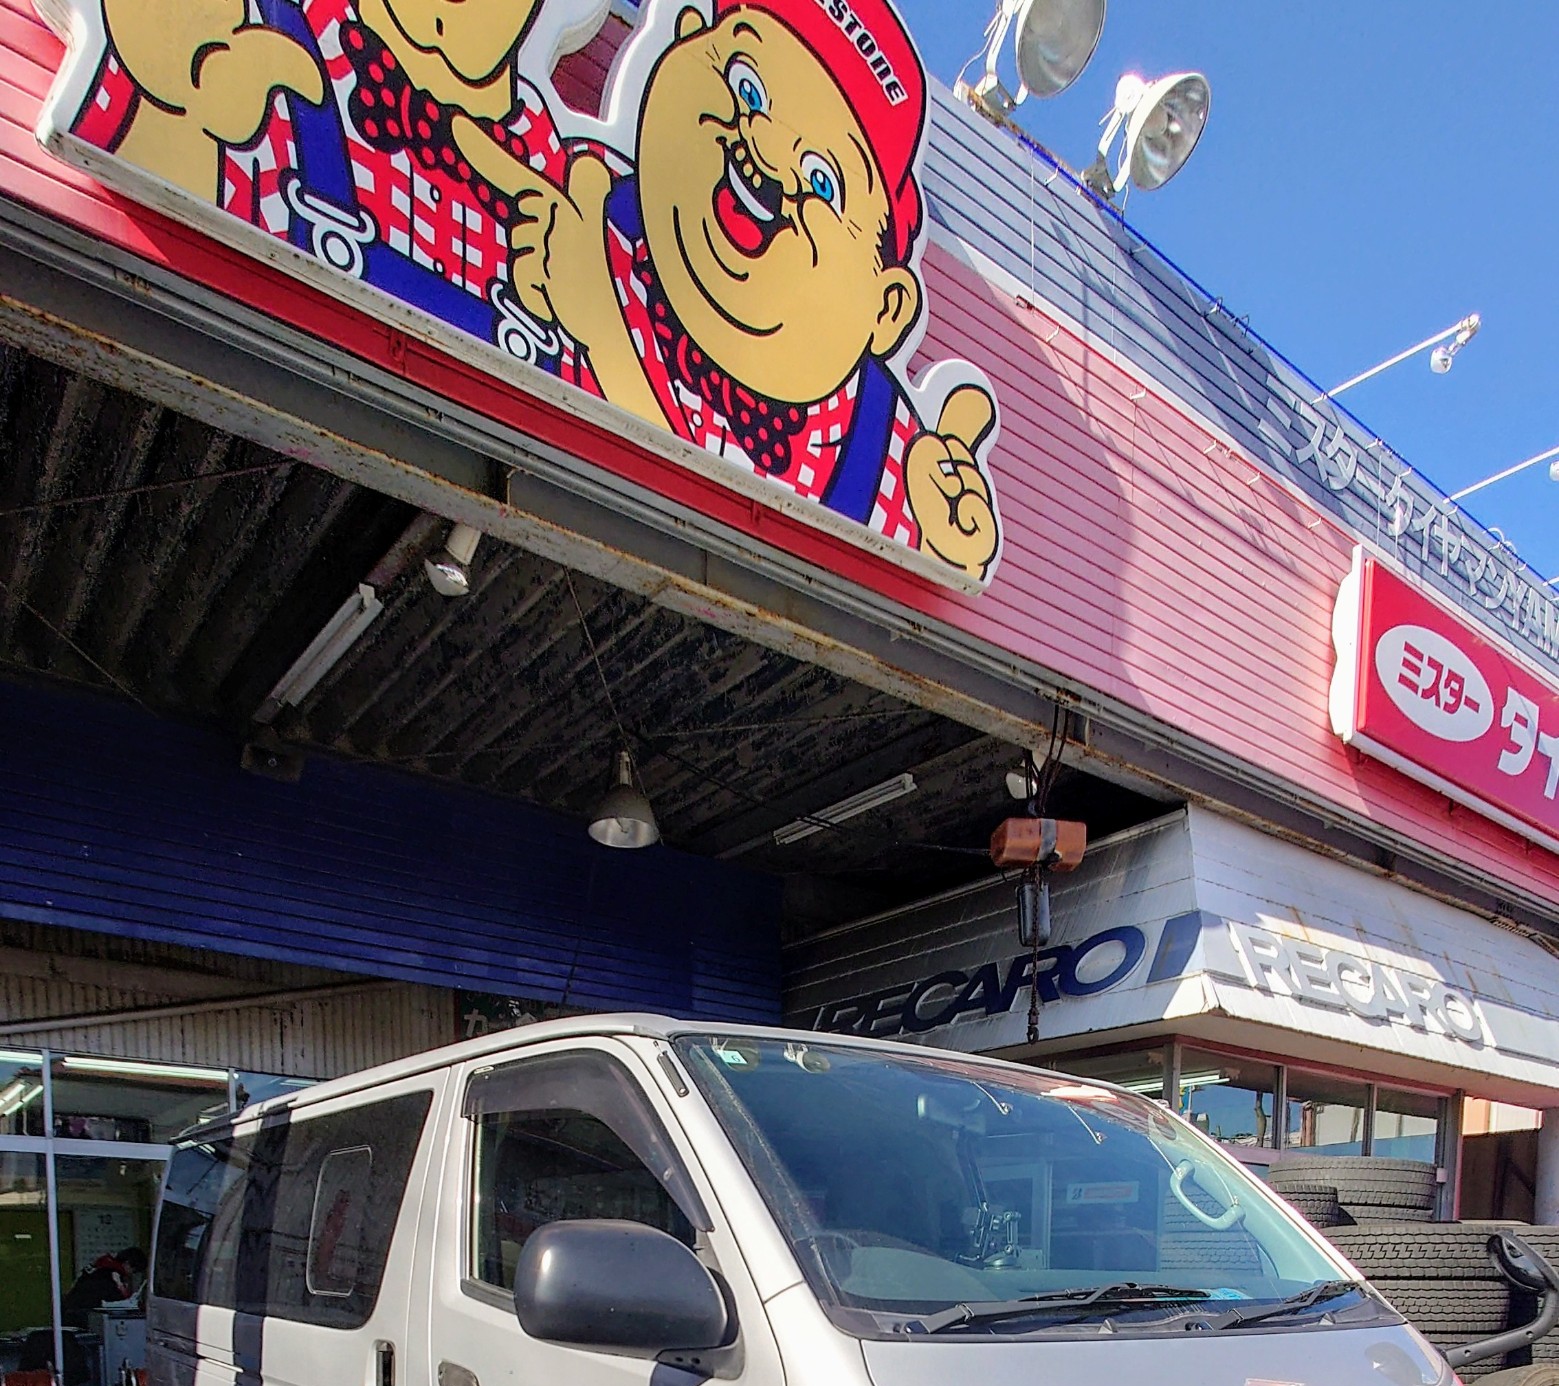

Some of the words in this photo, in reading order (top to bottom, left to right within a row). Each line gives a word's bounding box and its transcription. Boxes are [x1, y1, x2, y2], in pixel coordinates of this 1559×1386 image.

[815, 0, 908, 106] STONE
[1398, 641, 1480, 714] ミスター
[814, 926, 1147, 1037] RECARO
[1230, 922, 1484, 1044] RECARO
